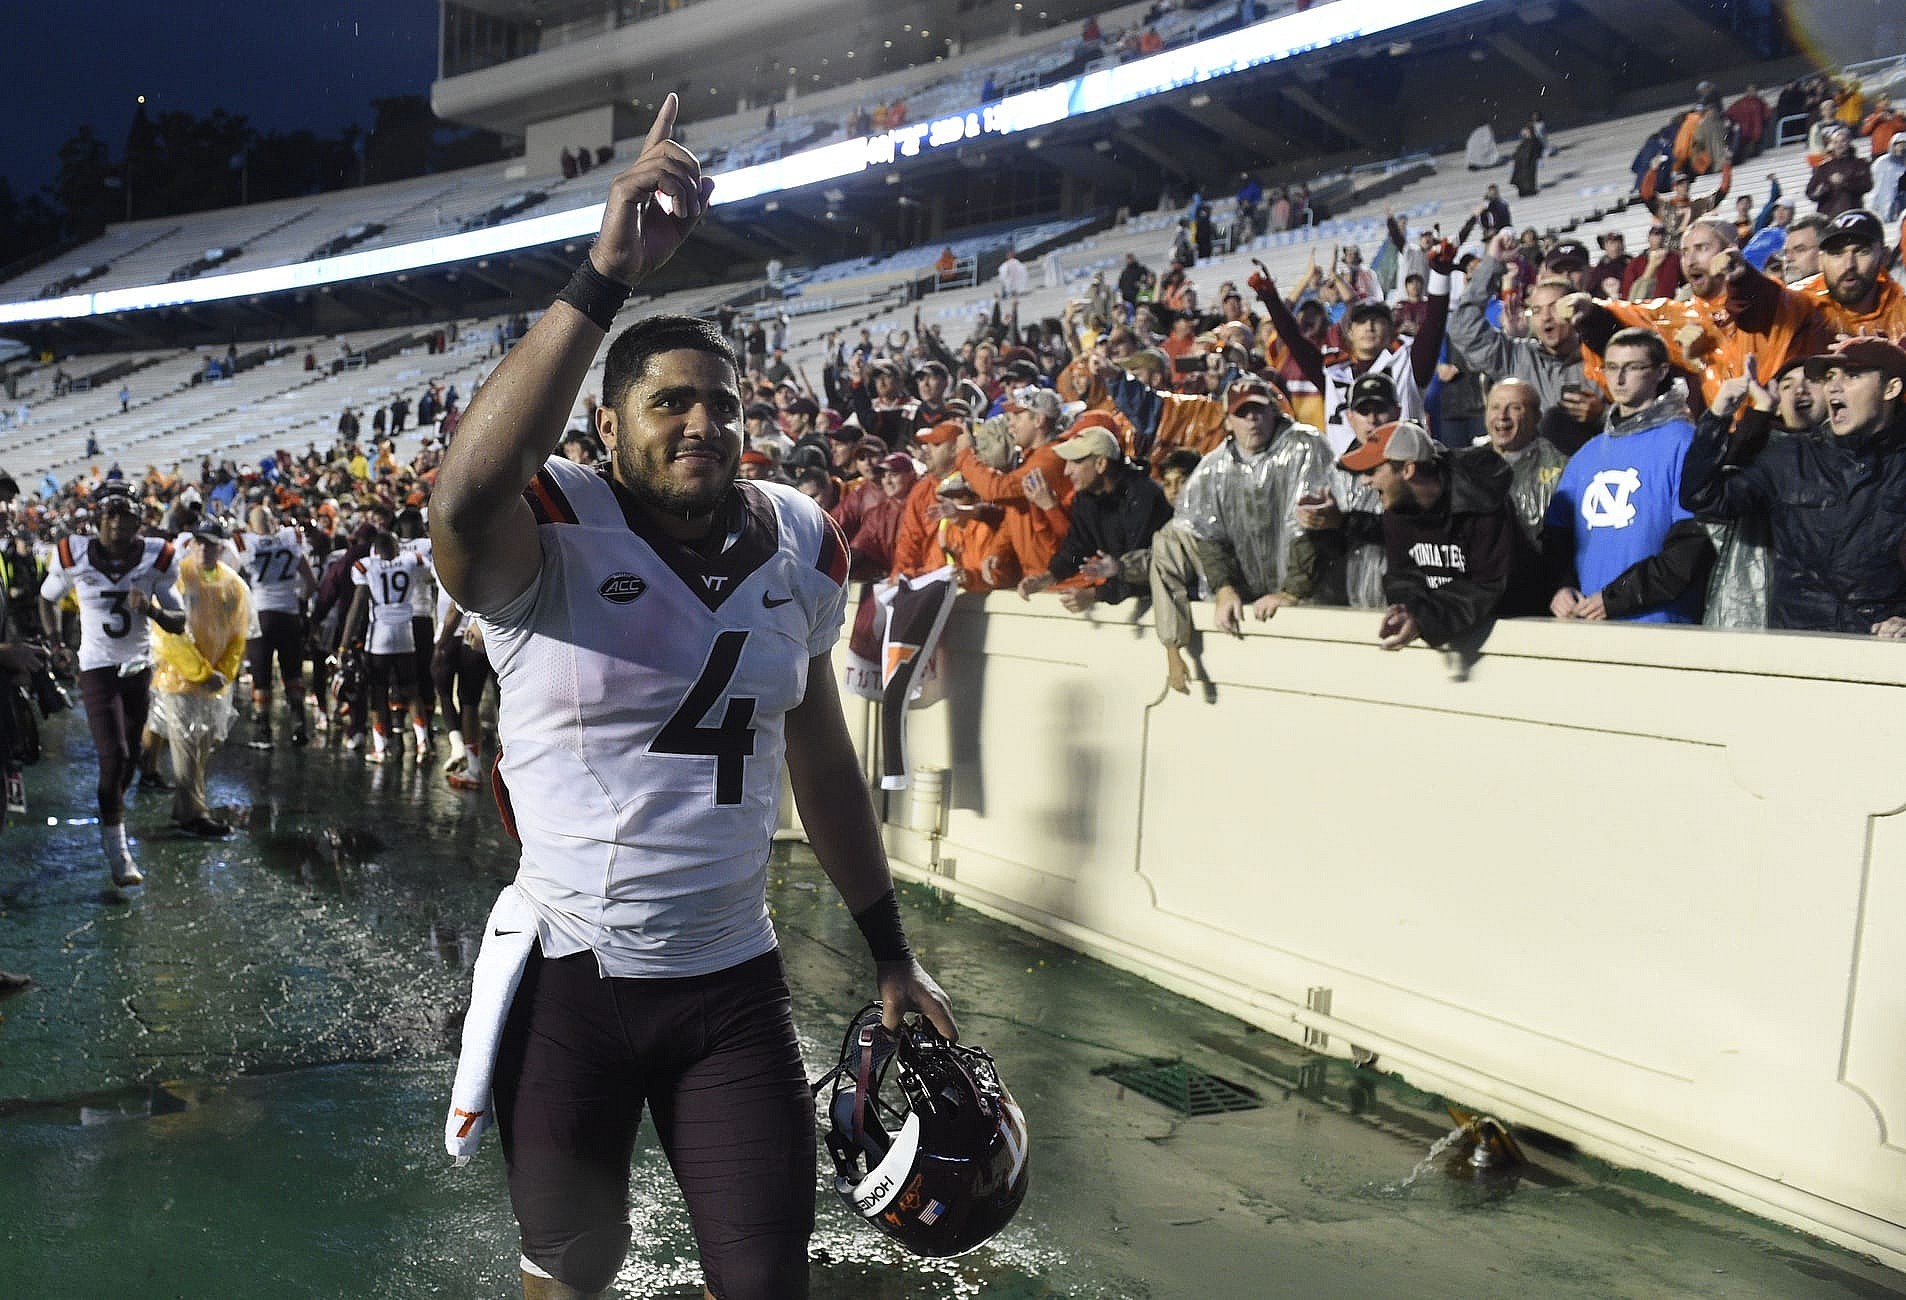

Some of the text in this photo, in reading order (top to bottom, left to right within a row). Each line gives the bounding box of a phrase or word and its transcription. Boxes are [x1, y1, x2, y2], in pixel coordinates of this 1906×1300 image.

[254, 549, 294, 582] 72
[379, 571, 409, 605] 19
[605, 580, 641, 592] ACC
[701, 575, 729, 591] VT
[100, 591, 131, 638] 3
[643, 629, 757, 807] 4
